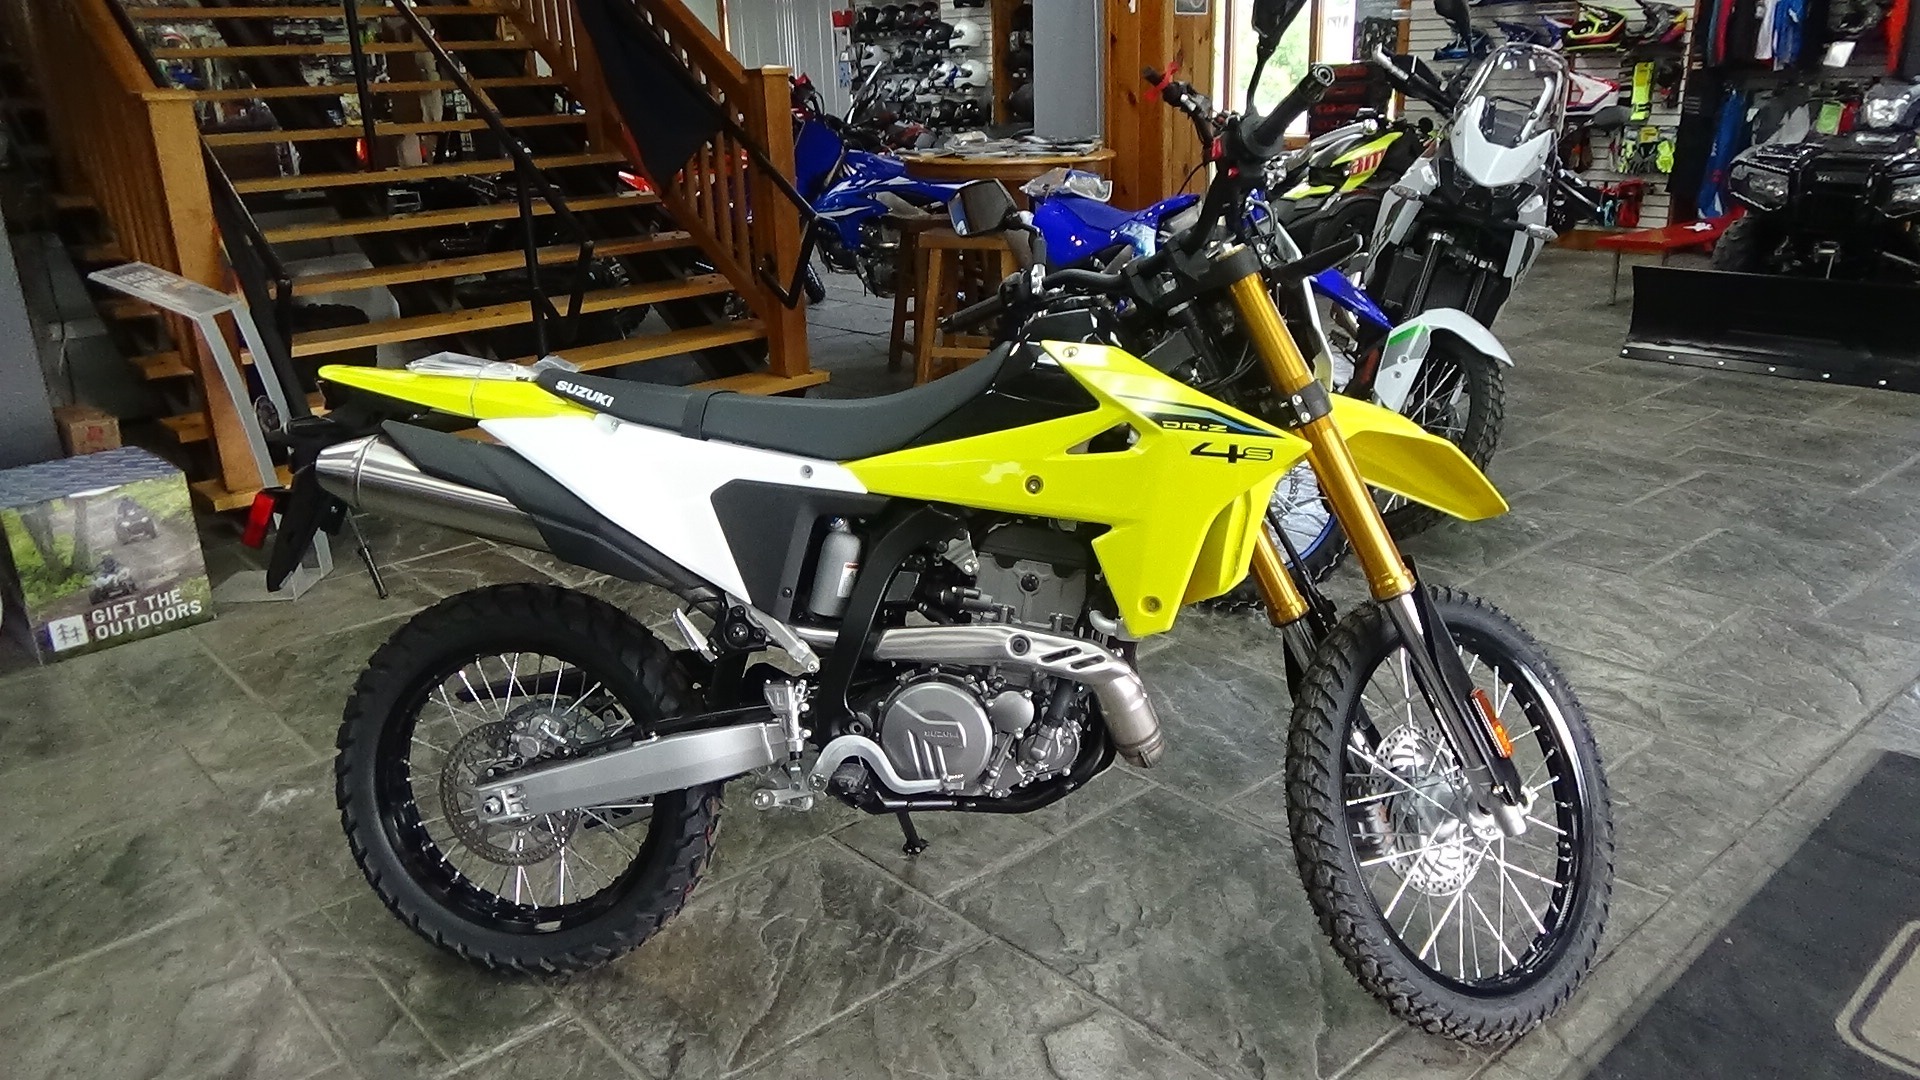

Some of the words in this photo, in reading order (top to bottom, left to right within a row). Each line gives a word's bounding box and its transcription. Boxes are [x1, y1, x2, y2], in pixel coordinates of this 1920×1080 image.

[555, 380, 615, 408] SUZUKI
[1162, 420, 1228, 433] DR-Z
[1190, 442, 1273, 464] 4S
[91, 599, 137, 625] GIFT
[144, 588, 183, 611] THE
[94, 599, 203, 641] OUTDOORS
